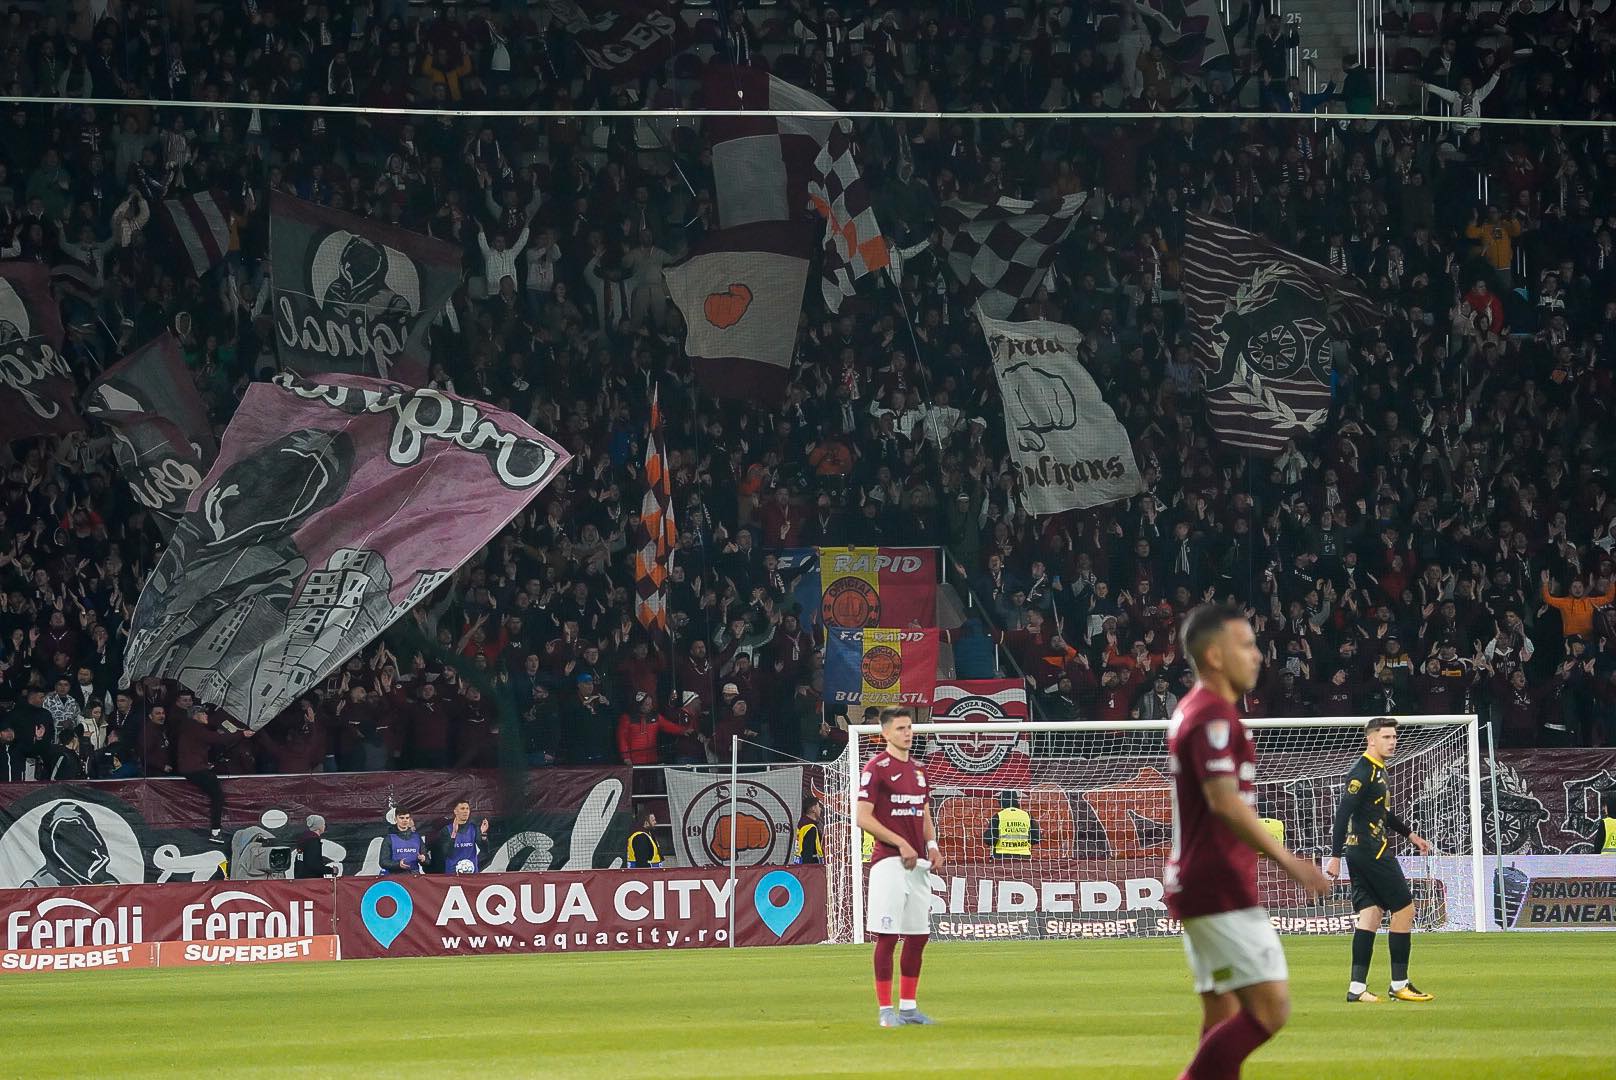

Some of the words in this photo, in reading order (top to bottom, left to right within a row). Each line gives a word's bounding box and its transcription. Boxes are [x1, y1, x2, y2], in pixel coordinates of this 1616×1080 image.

[1302, 48, 1319, 60] 24
[833, 554, 922, 573] RAPID
[873, 631, 925, 642] RAPID
[953, 701, 980, 715] PELUZA
[687, 825, 702, 837] 19
[775, 822, 792, 834] 98
[435, 882, 598, 926] AQUA
[613, 877, 739, 922] CITY
[938, 918, 1030, 937] SUPERBET
[1046, 918, 1138, 937] SUPERBET
[441, 926, 729, 951] www.aquacity.ro
[1, 945, 133, 971] SUPERBET
[184, 938, 313, 963] SUPERBET
